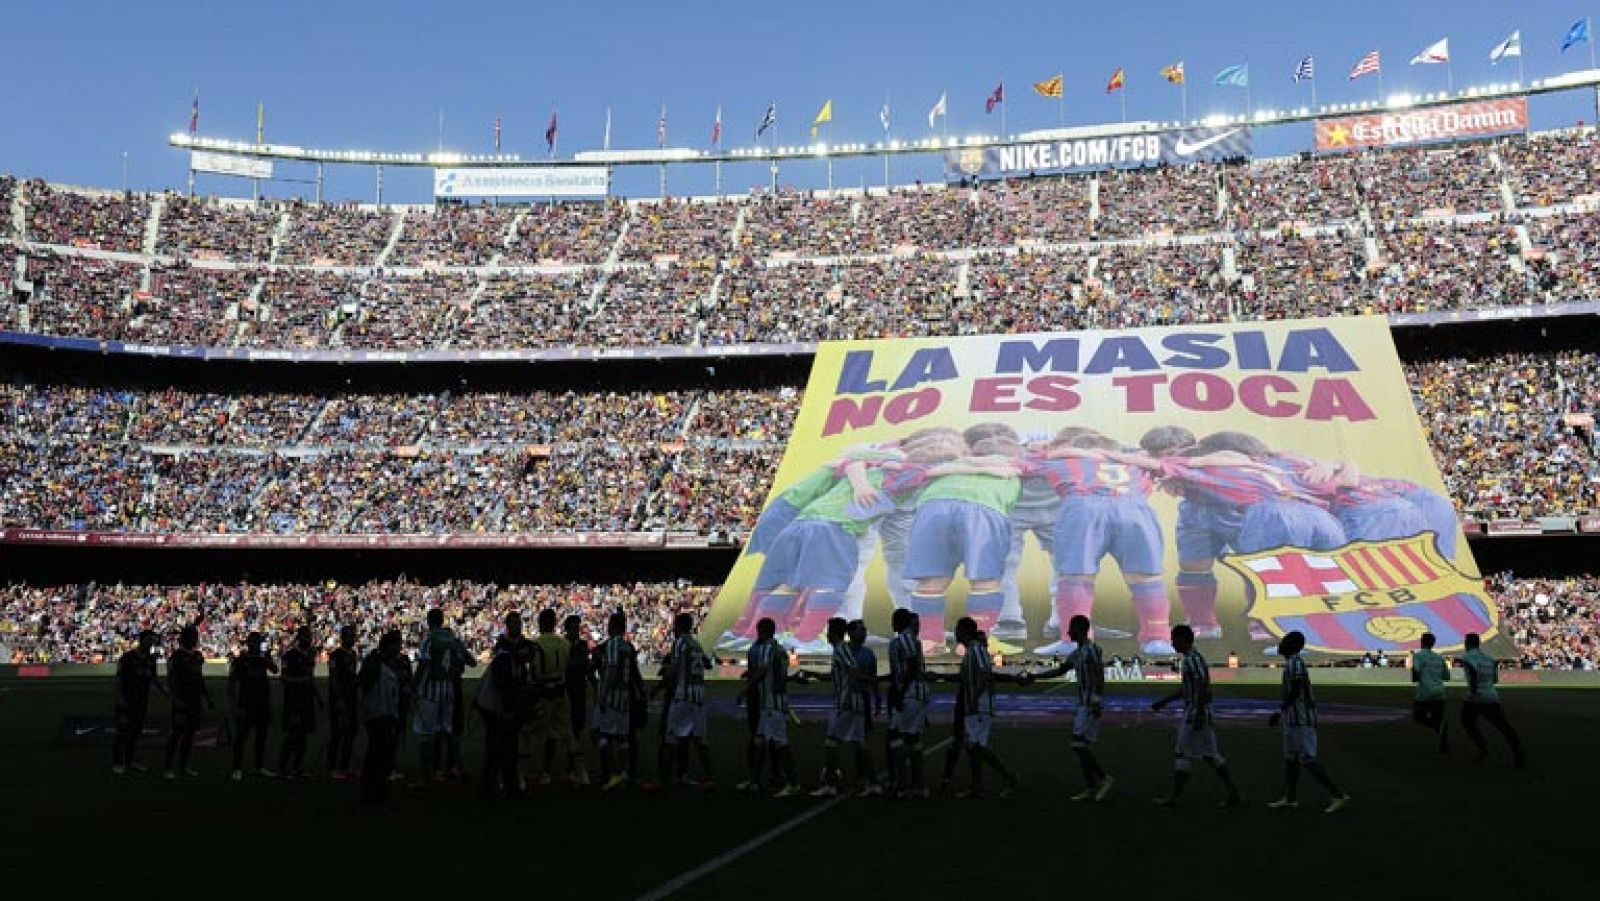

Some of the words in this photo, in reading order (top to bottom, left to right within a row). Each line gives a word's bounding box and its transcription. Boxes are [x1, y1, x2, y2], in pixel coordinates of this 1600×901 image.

[1443, 108, 1516, 133] Damm
[999, 136, 1159, 170] NIKE.COM/FCB
[836, 346, 959, 395] LA
[995, 327, 1361, 374] MASIA
[821, 387, 942, 438] NO
[969, 375, 1082, 412] ES
[1112, 372, 1378, 422] TOCA
[1320, 587, 1417, 612] FCB
